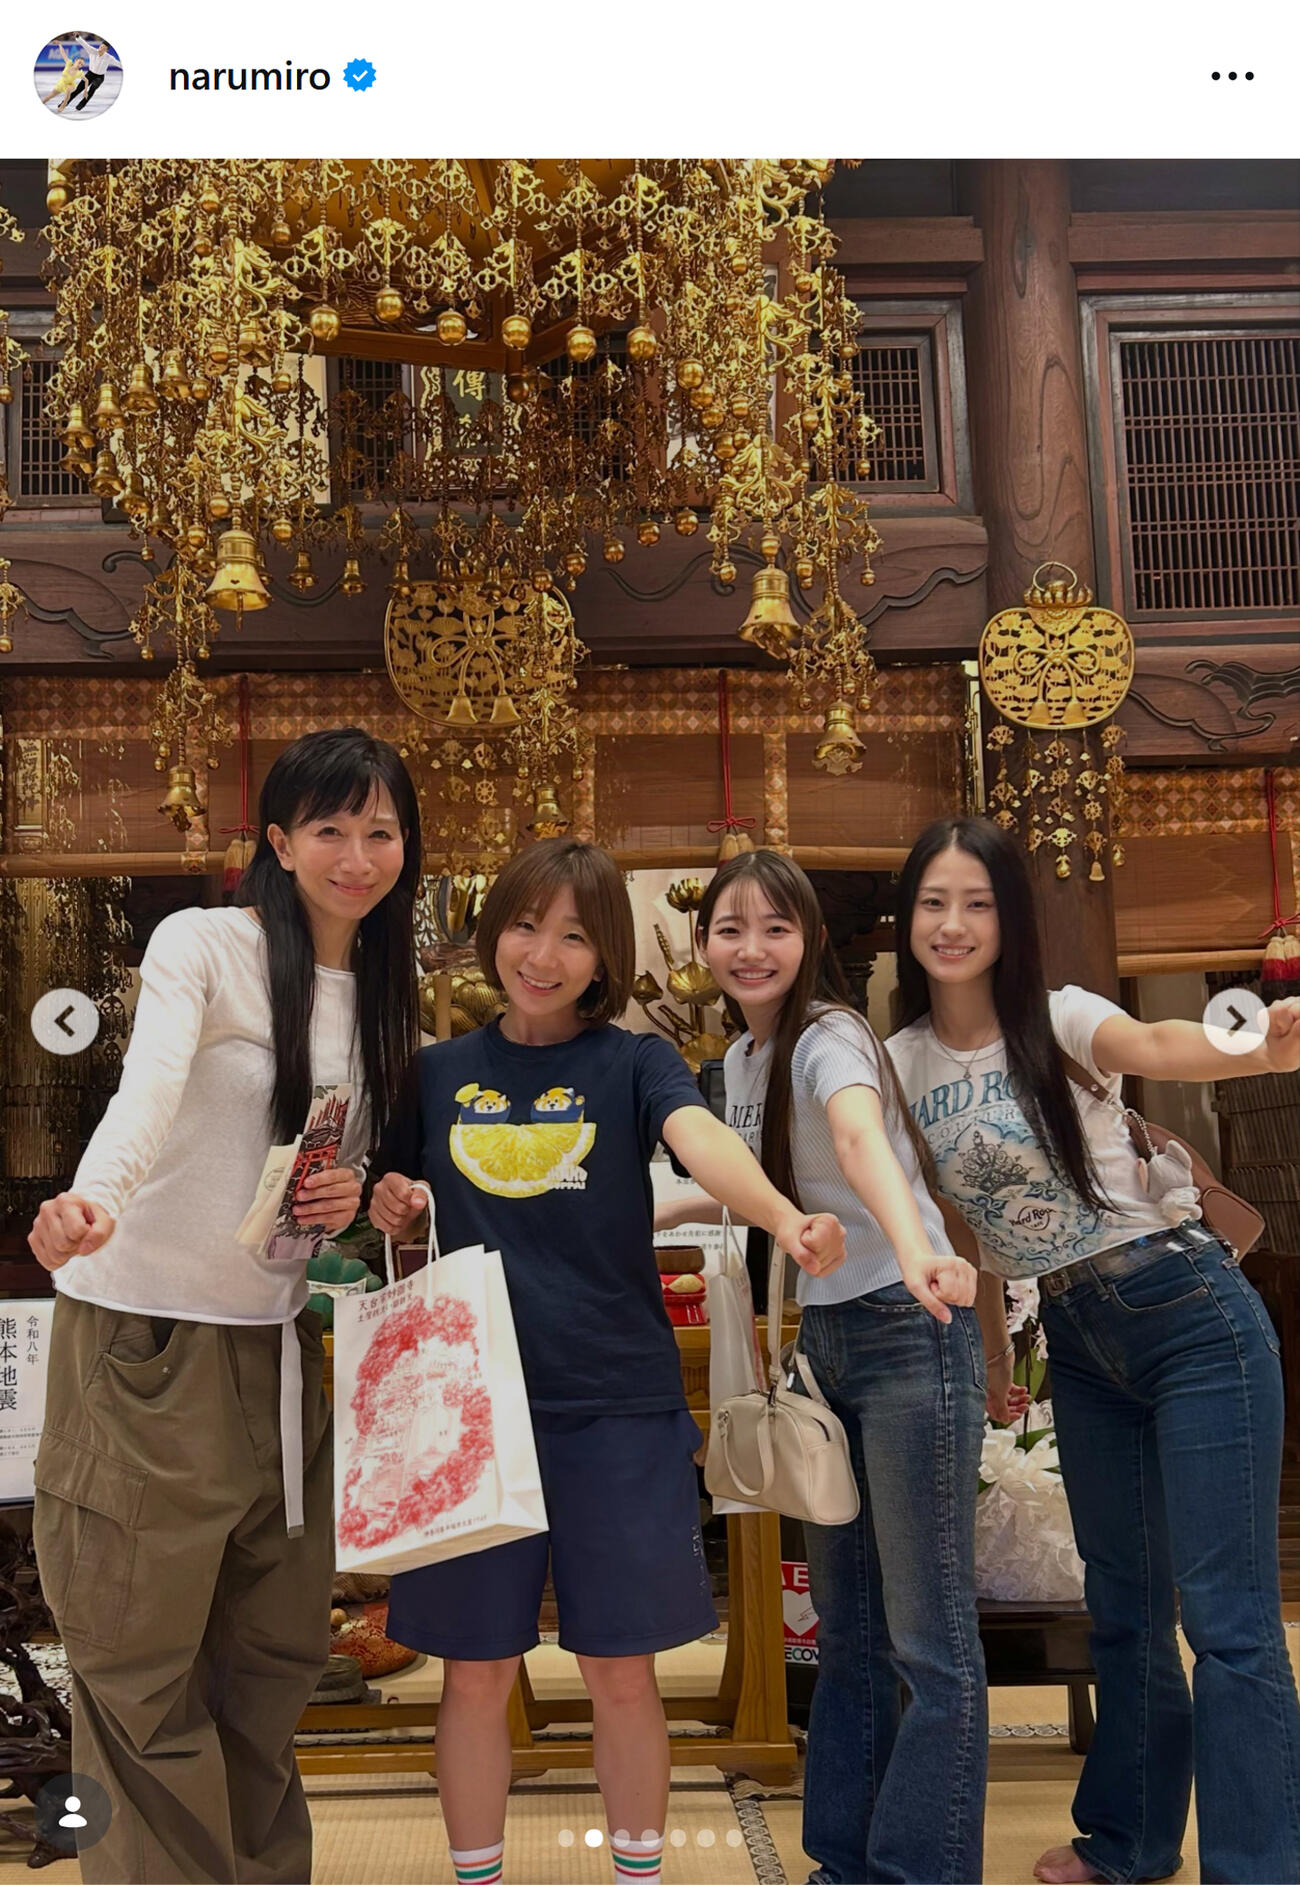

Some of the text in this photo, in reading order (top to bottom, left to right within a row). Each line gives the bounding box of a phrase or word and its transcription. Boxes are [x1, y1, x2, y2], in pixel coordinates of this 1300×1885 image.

[0, 1317, 18, 1412] 熊本地震
[26, 1315, 40, 1365] 令和八年
